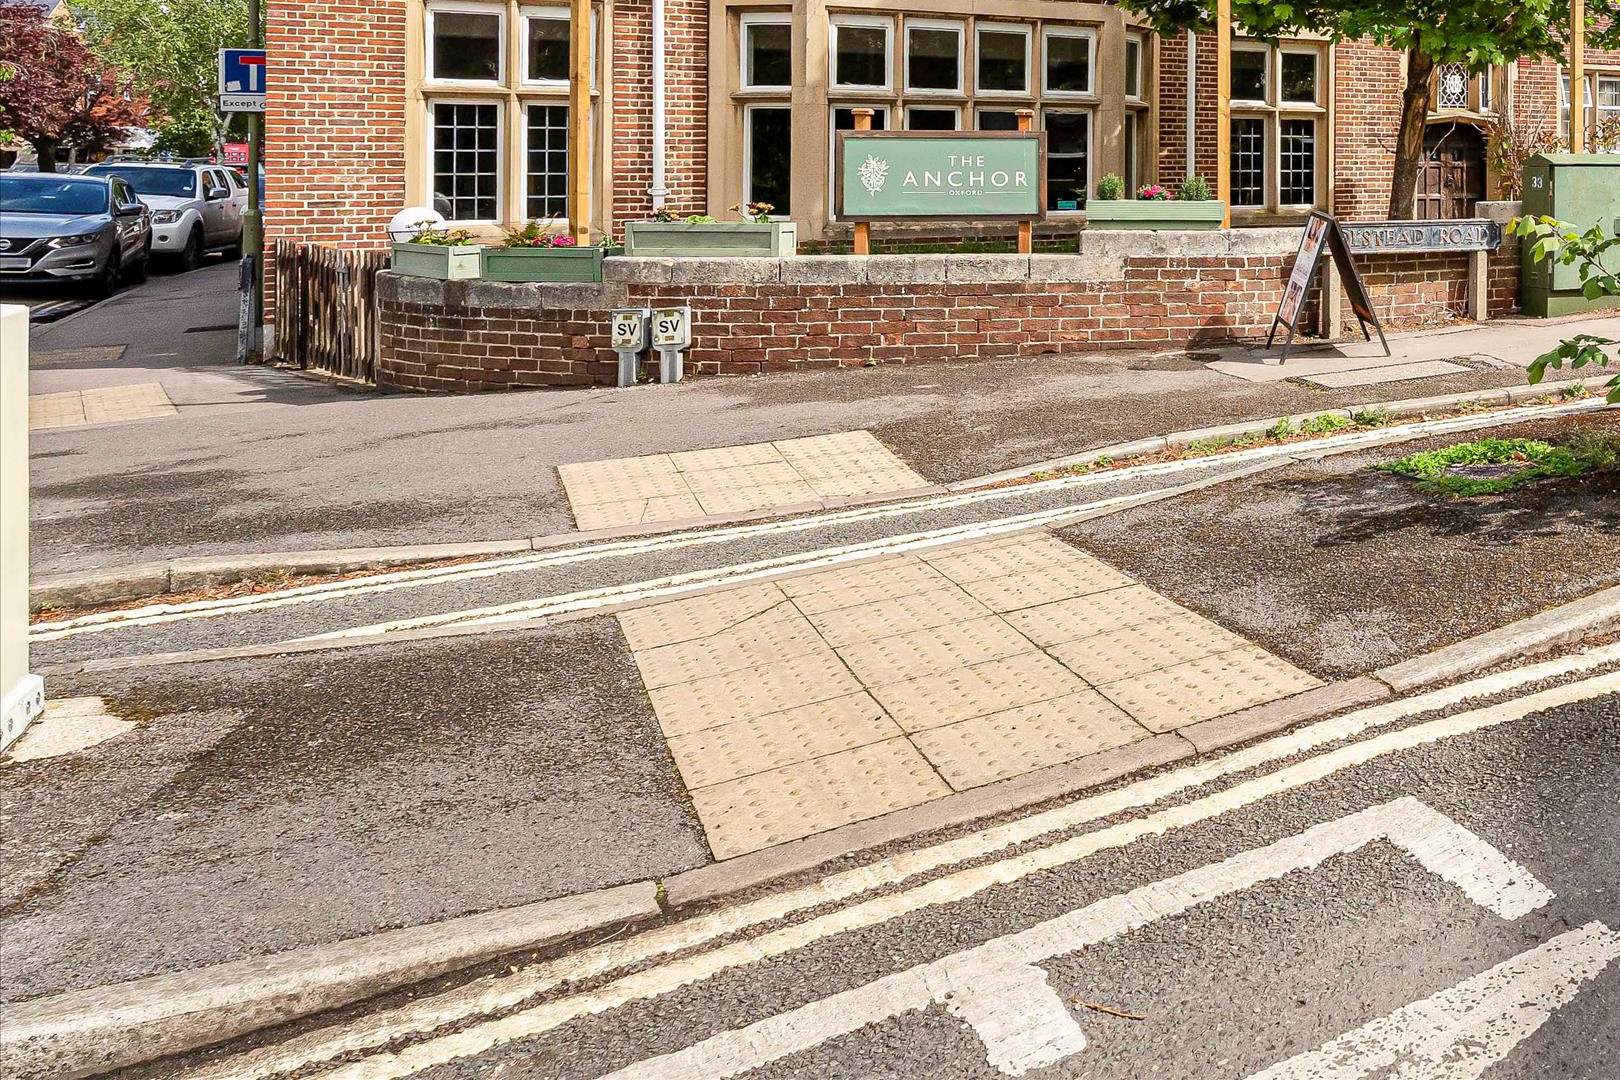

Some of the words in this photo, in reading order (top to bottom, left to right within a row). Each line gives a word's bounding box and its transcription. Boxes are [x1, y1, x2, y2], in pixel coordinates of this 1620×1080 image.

[222, 100, 257, 108] Except
[947, 155, 985, 167] THE
[902, 171, 1029, 188] ANCHOR
[1531, 176, 1543, 189] 33
[1323, 228, 1425, 247] LSTEAD
[1438, 225, 1490, 245] ROAD
[617, 323, 638, 337] SV
[658, 319, 680, 334] SV
